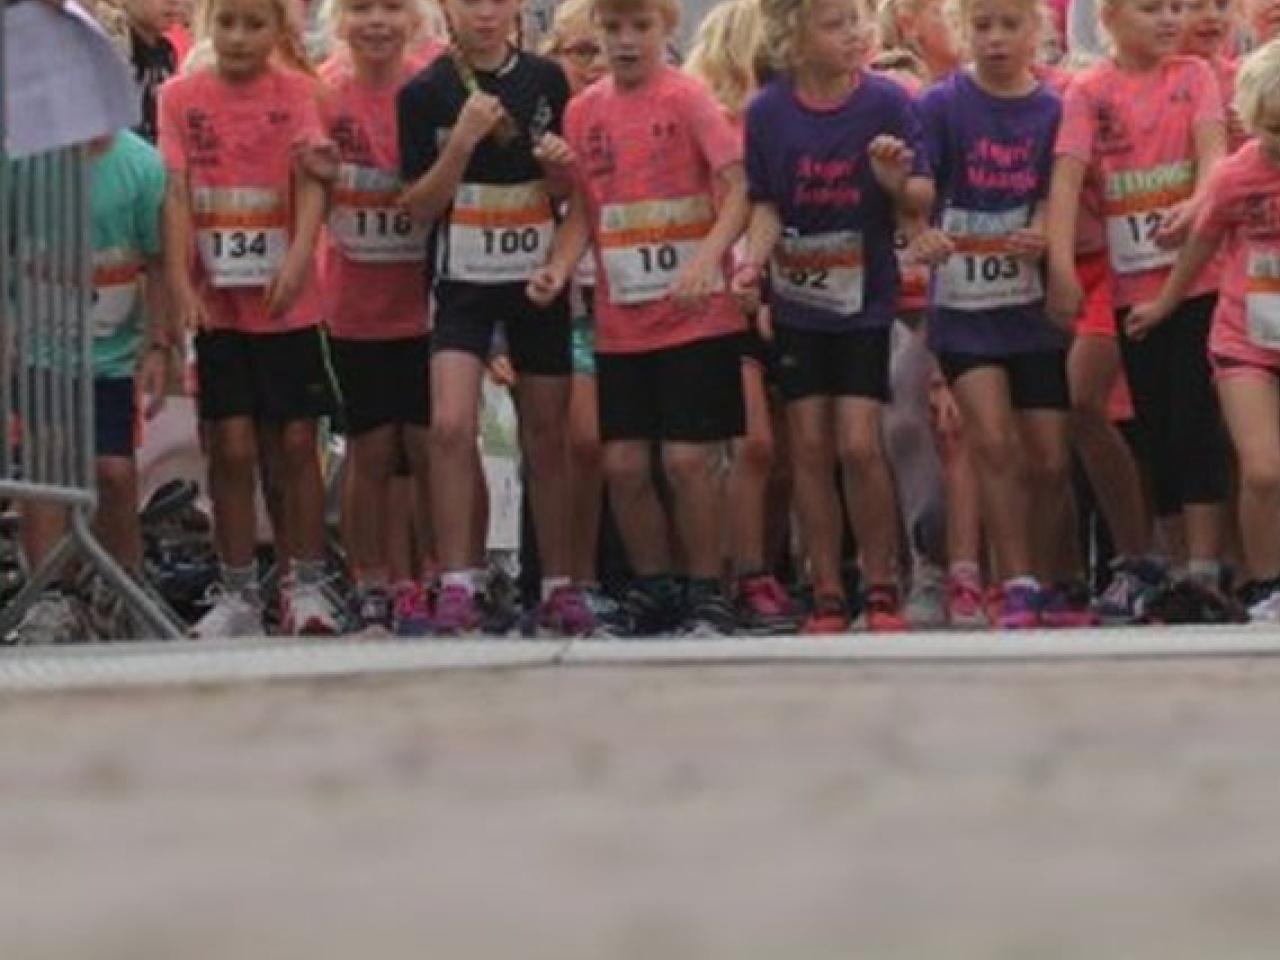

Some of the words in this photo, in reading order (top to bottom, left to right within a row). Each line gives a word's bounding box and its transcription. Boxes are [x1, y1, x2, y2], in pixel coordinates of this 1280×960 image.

[212, 230, 267, 259] 134
[482, 227, 539, 255] 100
[636, 243, 678, 273] 10
[963, 255, 1020, 282] 103
